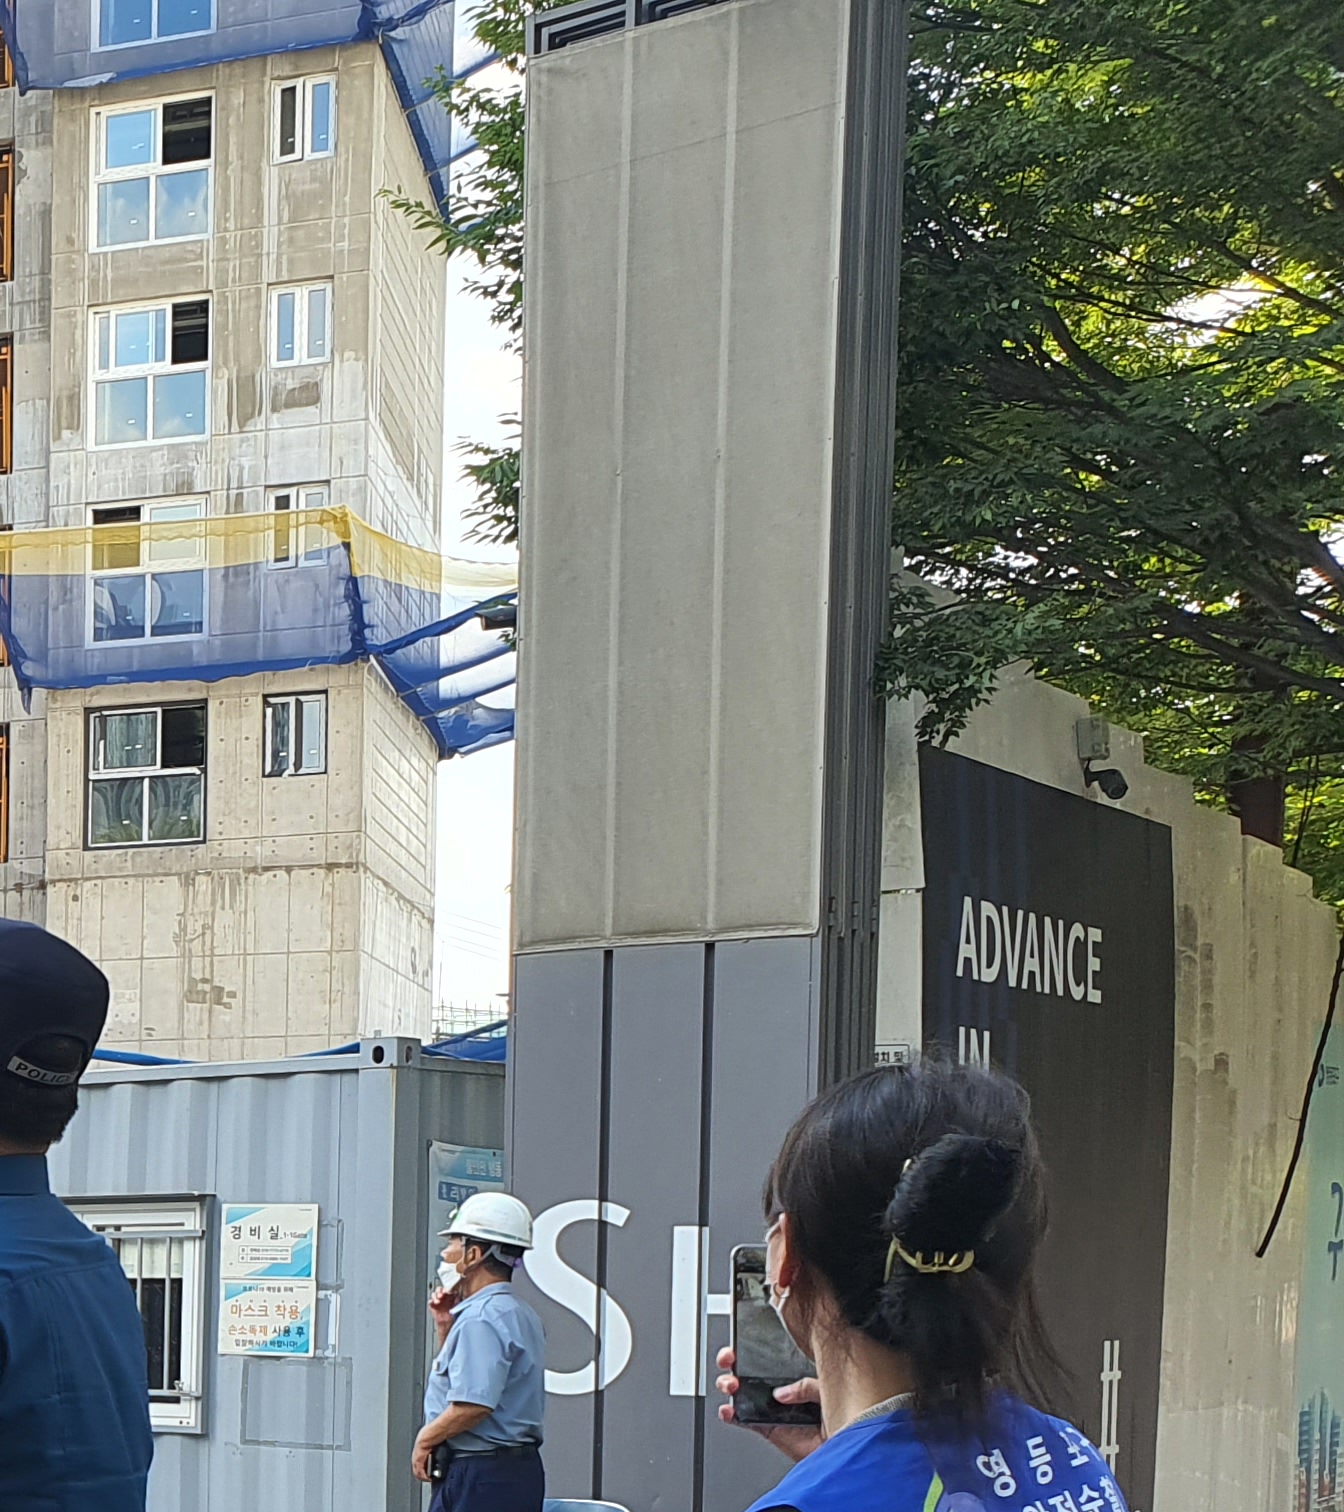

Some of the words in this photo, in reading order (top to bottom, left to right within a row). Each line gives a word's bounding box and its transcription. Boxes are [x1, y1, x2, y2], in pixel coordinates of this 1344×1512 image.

[955, 895, 1103, 1005] ADVANCE
[230, 1303, 270, 1319] 마스크
[271, 1325, 292, 1338] 사용
